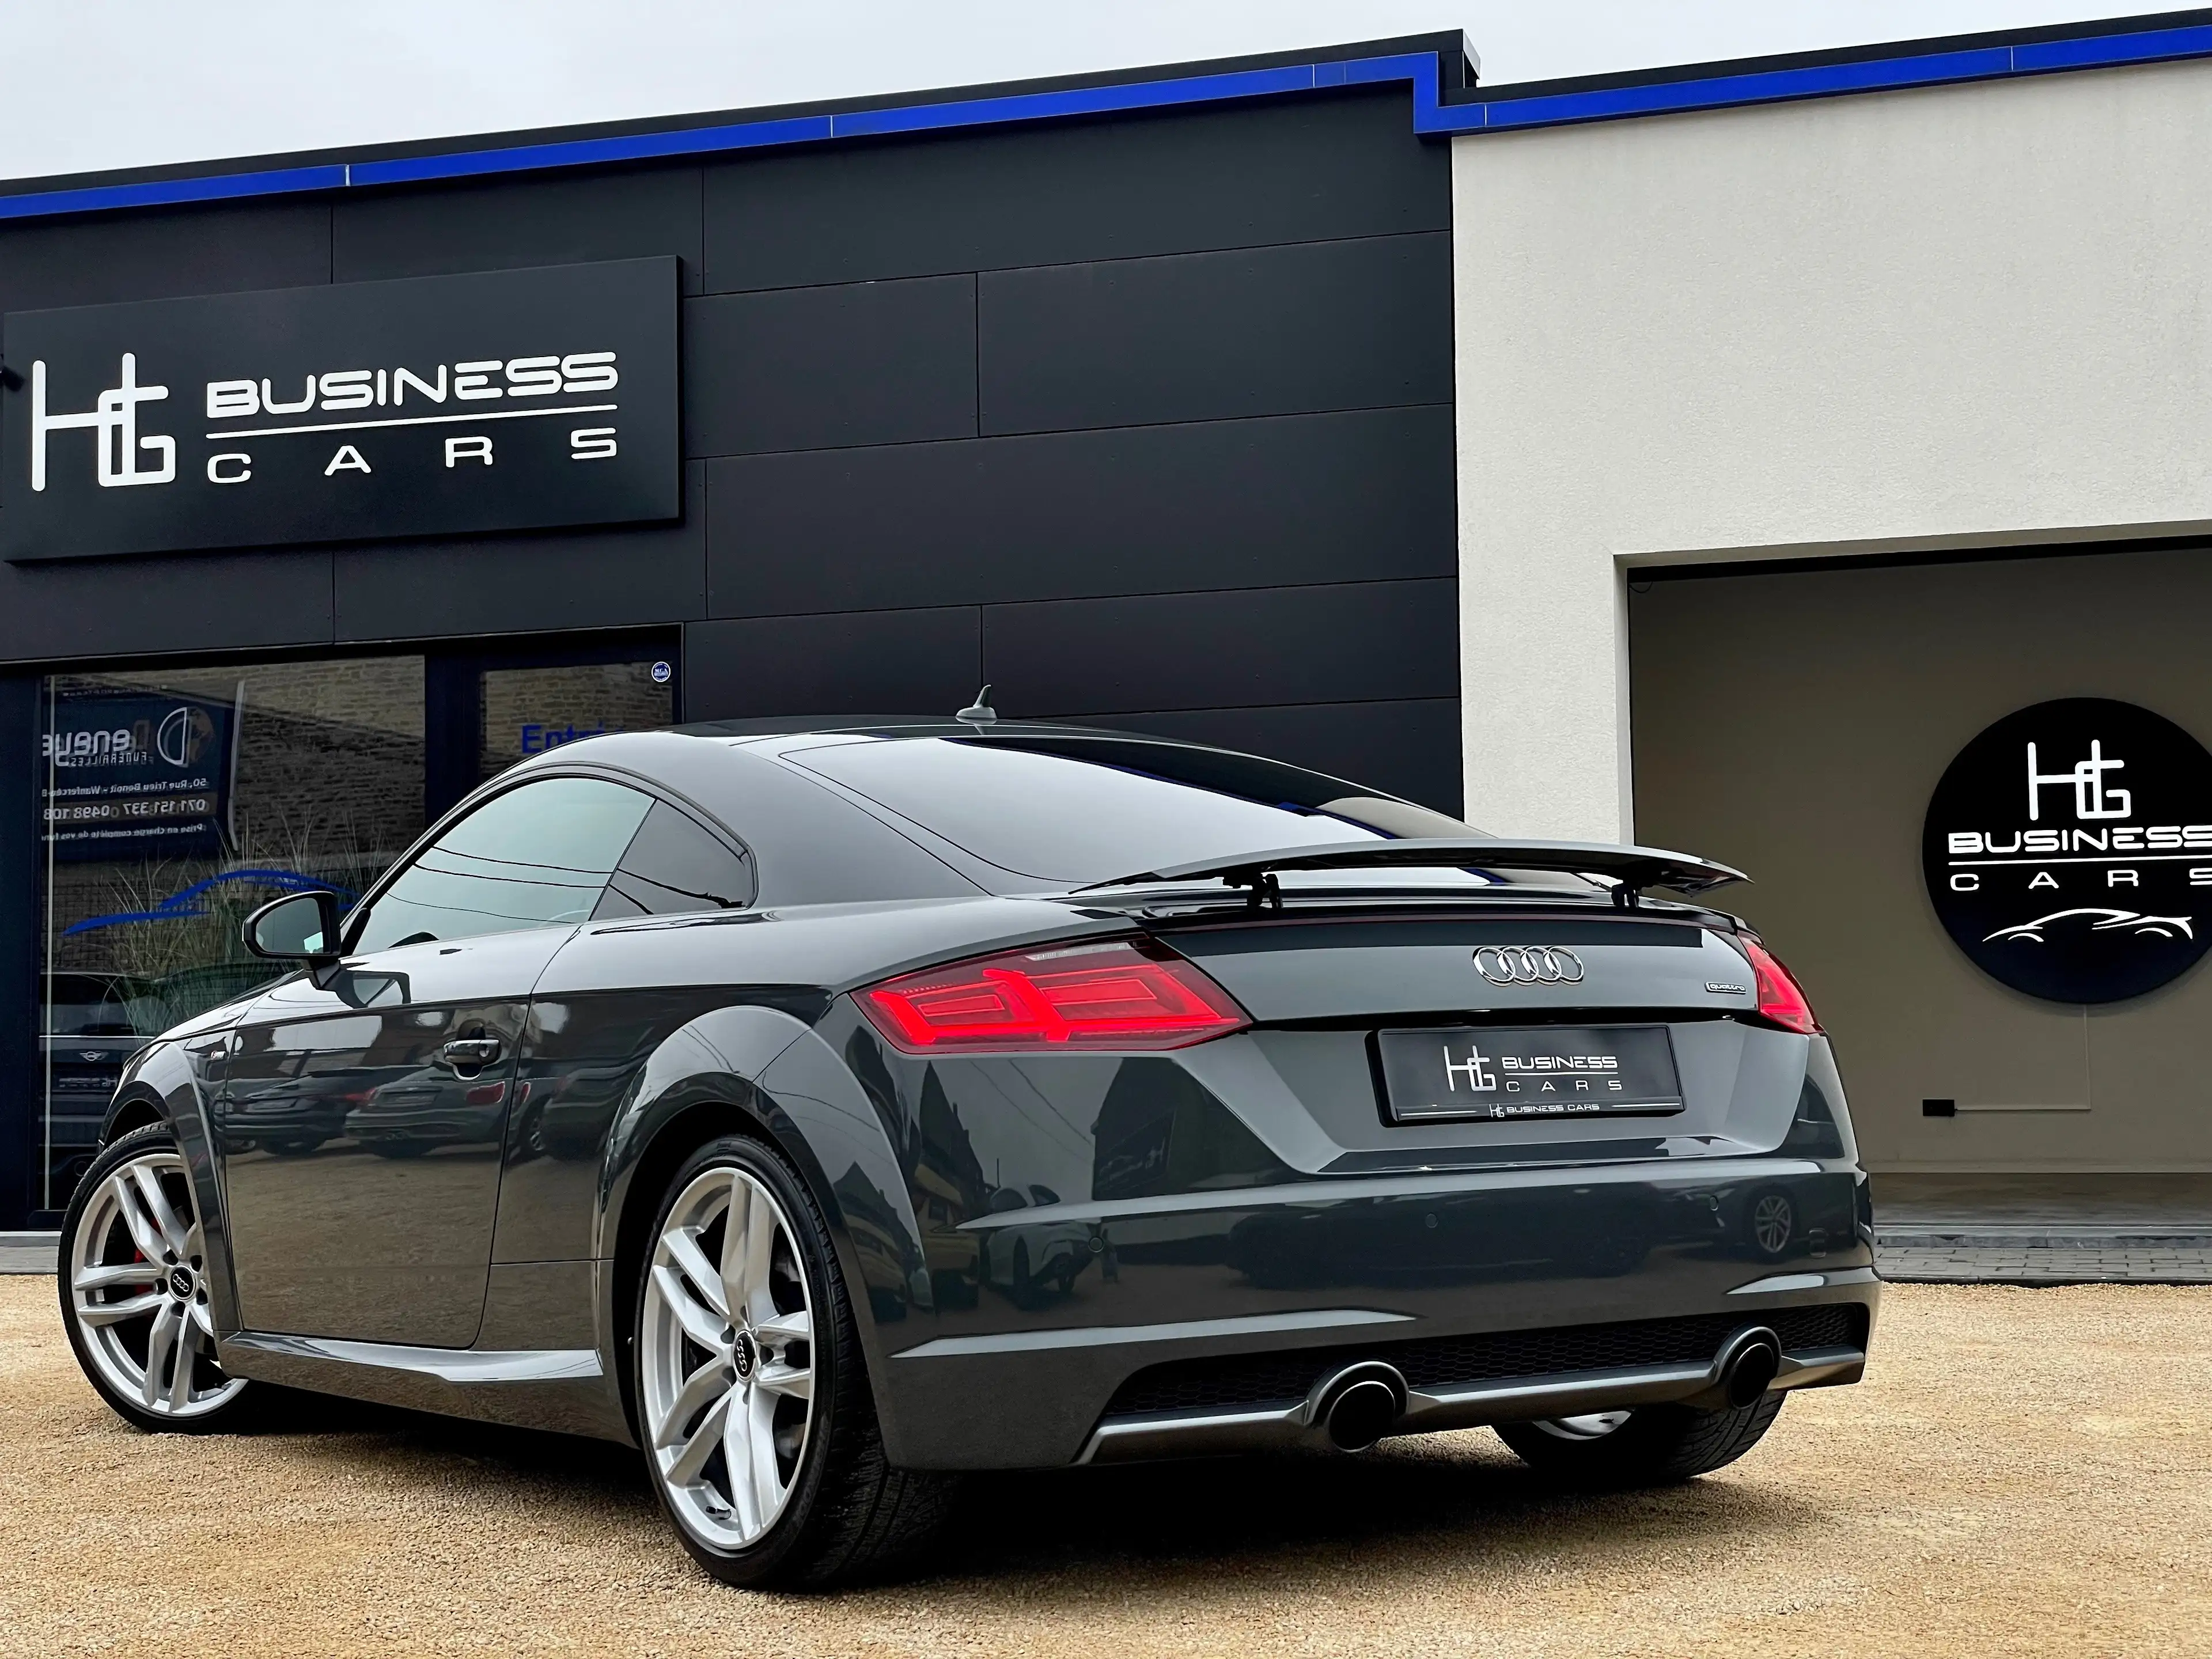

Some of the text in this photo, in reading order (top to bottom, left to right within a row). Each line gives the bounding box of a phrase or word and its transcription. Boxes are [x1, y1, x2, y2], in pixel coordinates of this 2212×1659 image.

[207, 351, 618, 418] BUSINESS
[207, 427, 618, 483] CARS
[1948, 825, 2212, 854] BUSINESS
[1501, 1056, 1618, 1069] BUSINESS
[1506, 1080, 1623, 1092] CARS
[1506, 1104, 1565, 1113] BUSINESS
[1567, 1103, 1600, 1112] CARS
